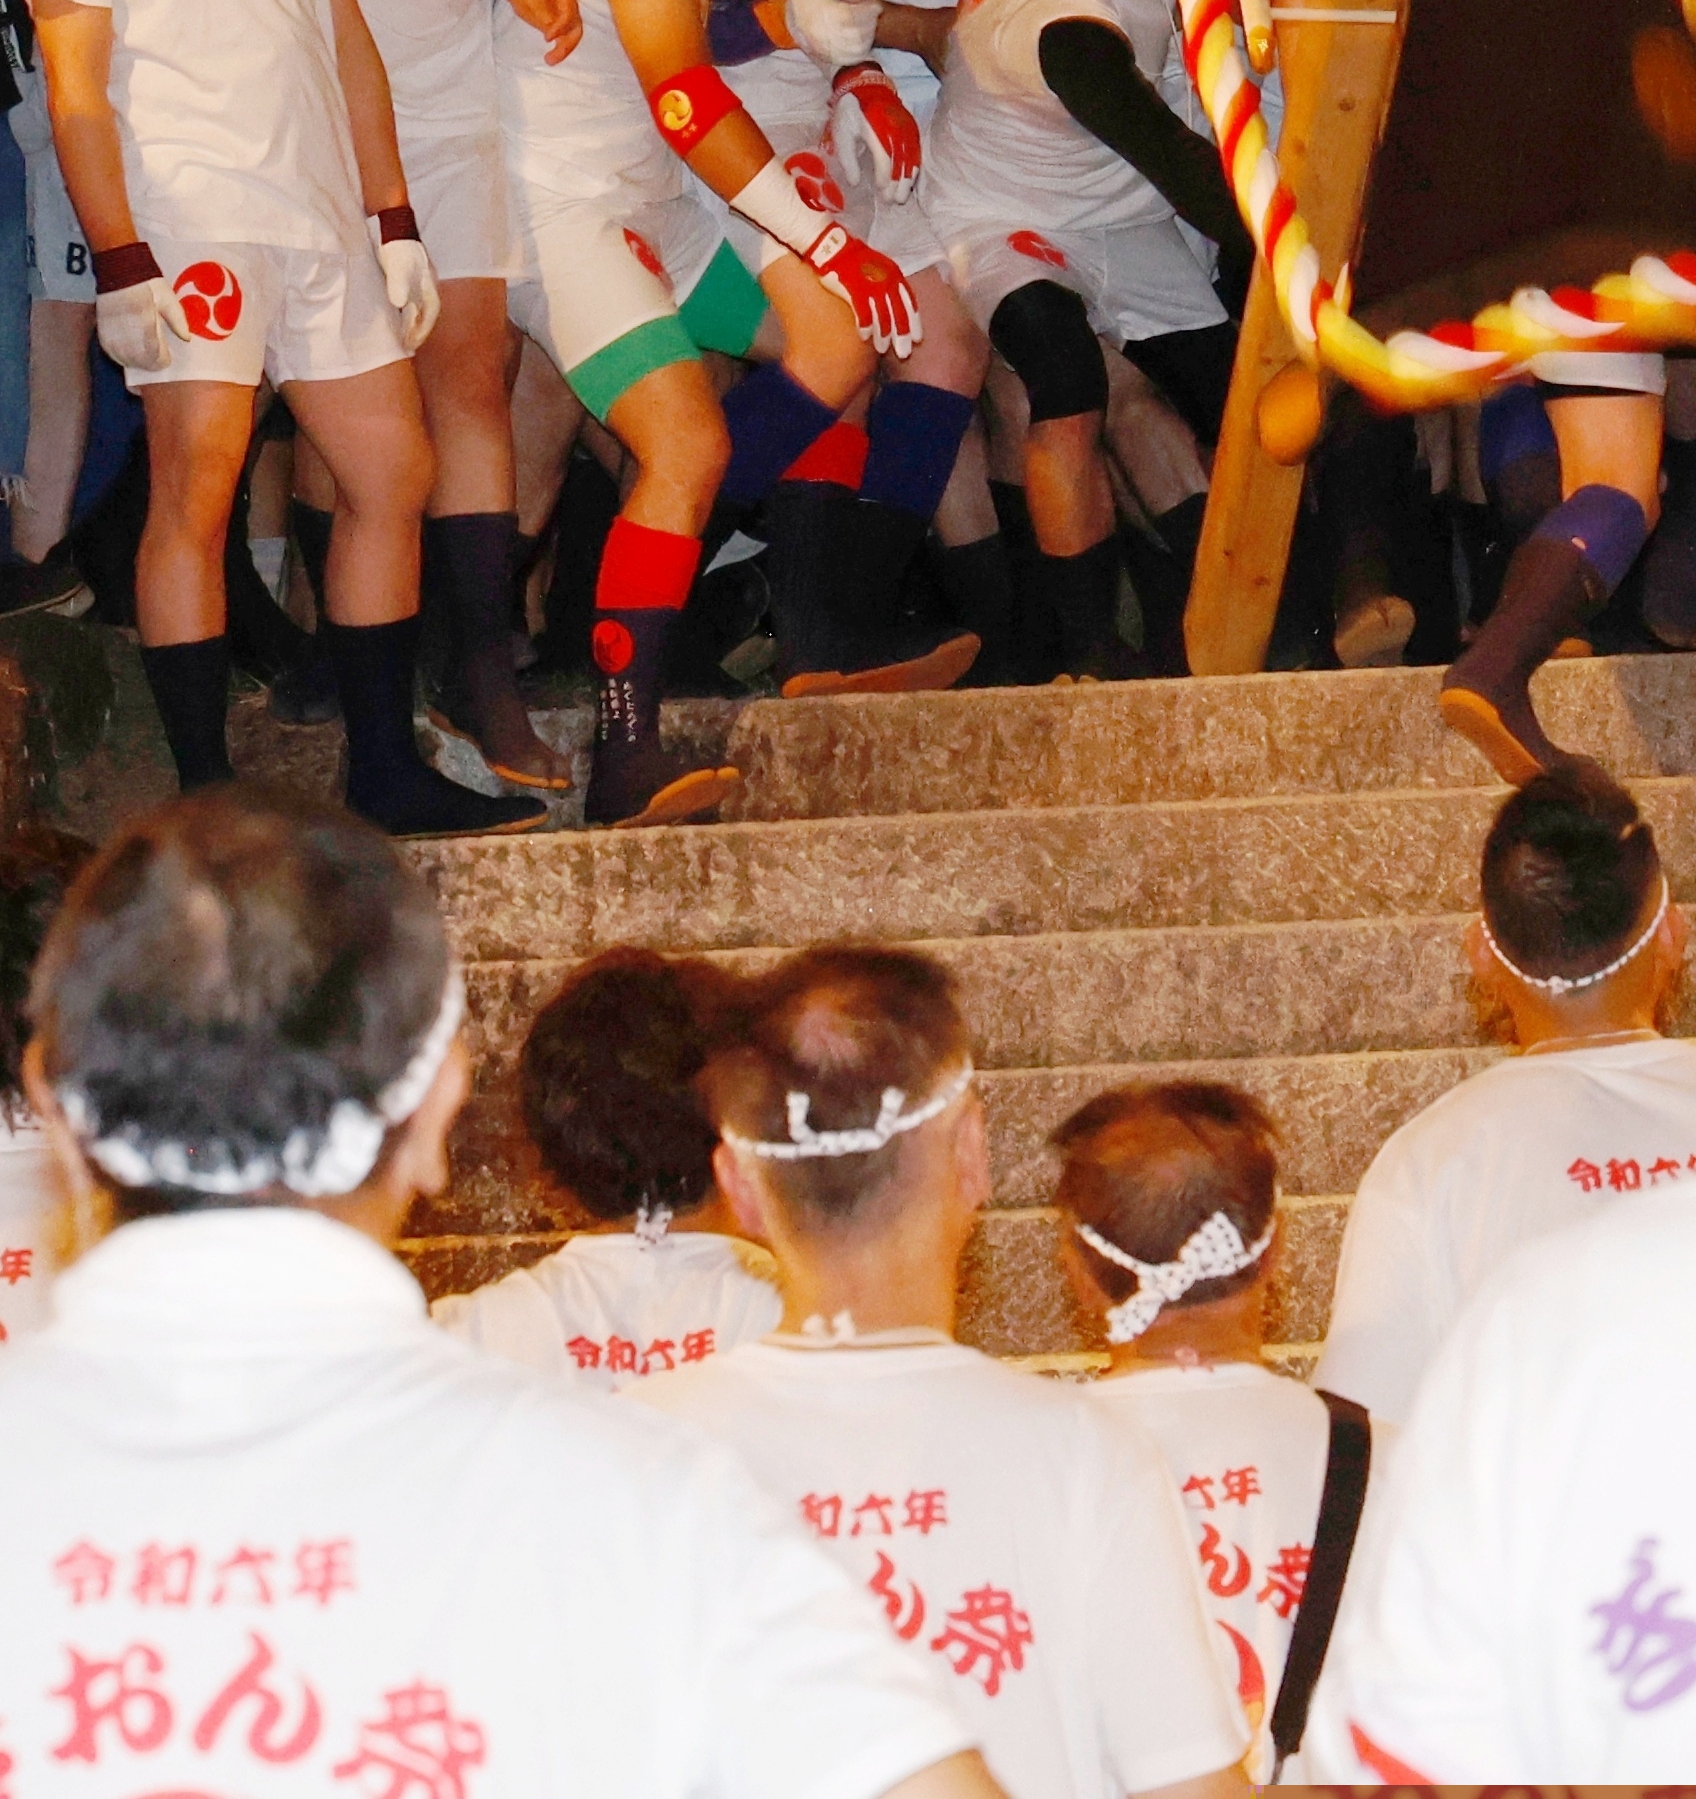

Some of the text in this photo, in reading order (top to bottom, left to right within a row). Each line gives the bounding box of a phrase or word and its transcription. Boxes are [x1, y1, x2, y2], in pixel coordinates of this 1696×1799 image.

[565, 1327, 716, 1376] 令和六年
[51, 1536, 356, 1607] 令和六年
